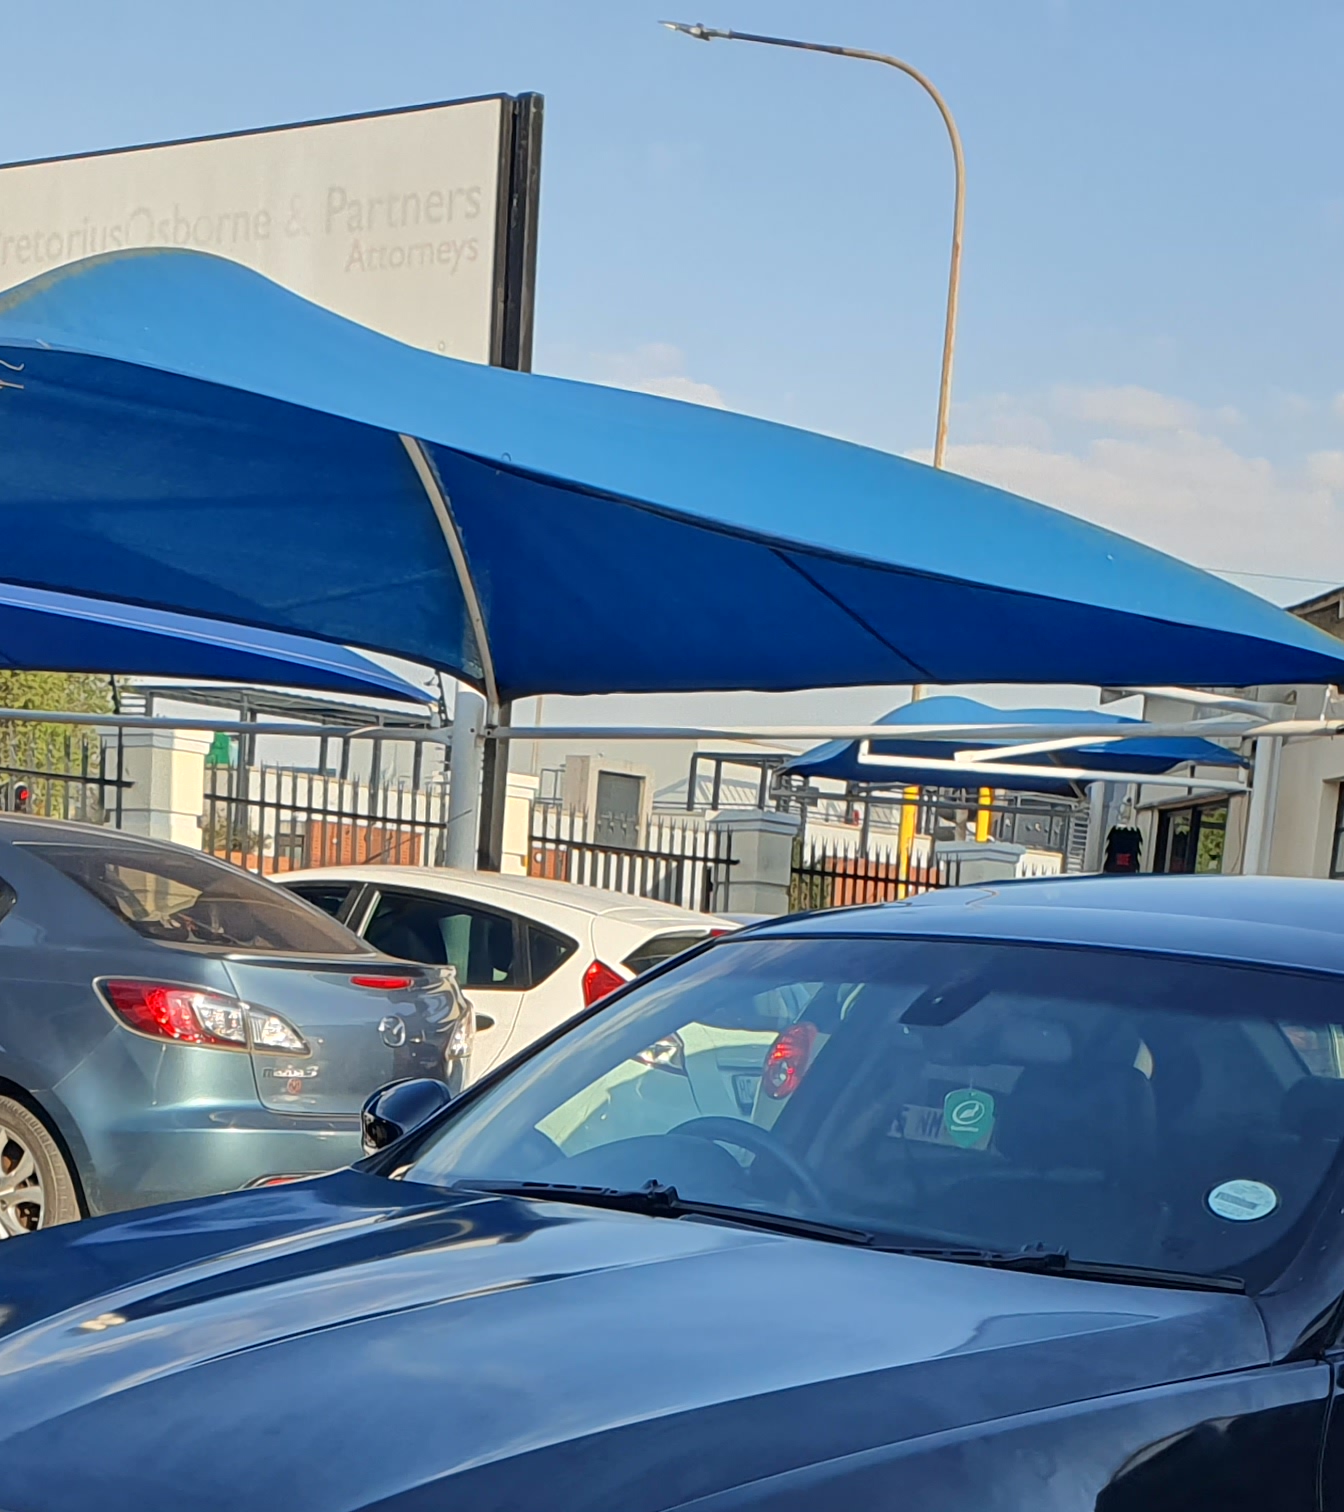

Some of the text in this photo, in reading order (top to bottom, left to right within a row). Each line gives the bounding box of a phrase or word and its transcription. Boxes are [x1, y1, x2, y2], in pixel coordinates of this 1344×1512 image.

[126, 203, 272, 247] Osborne
[325, 185, 482, 235] Partners
[344, 237, 479, 276] Attorneys
